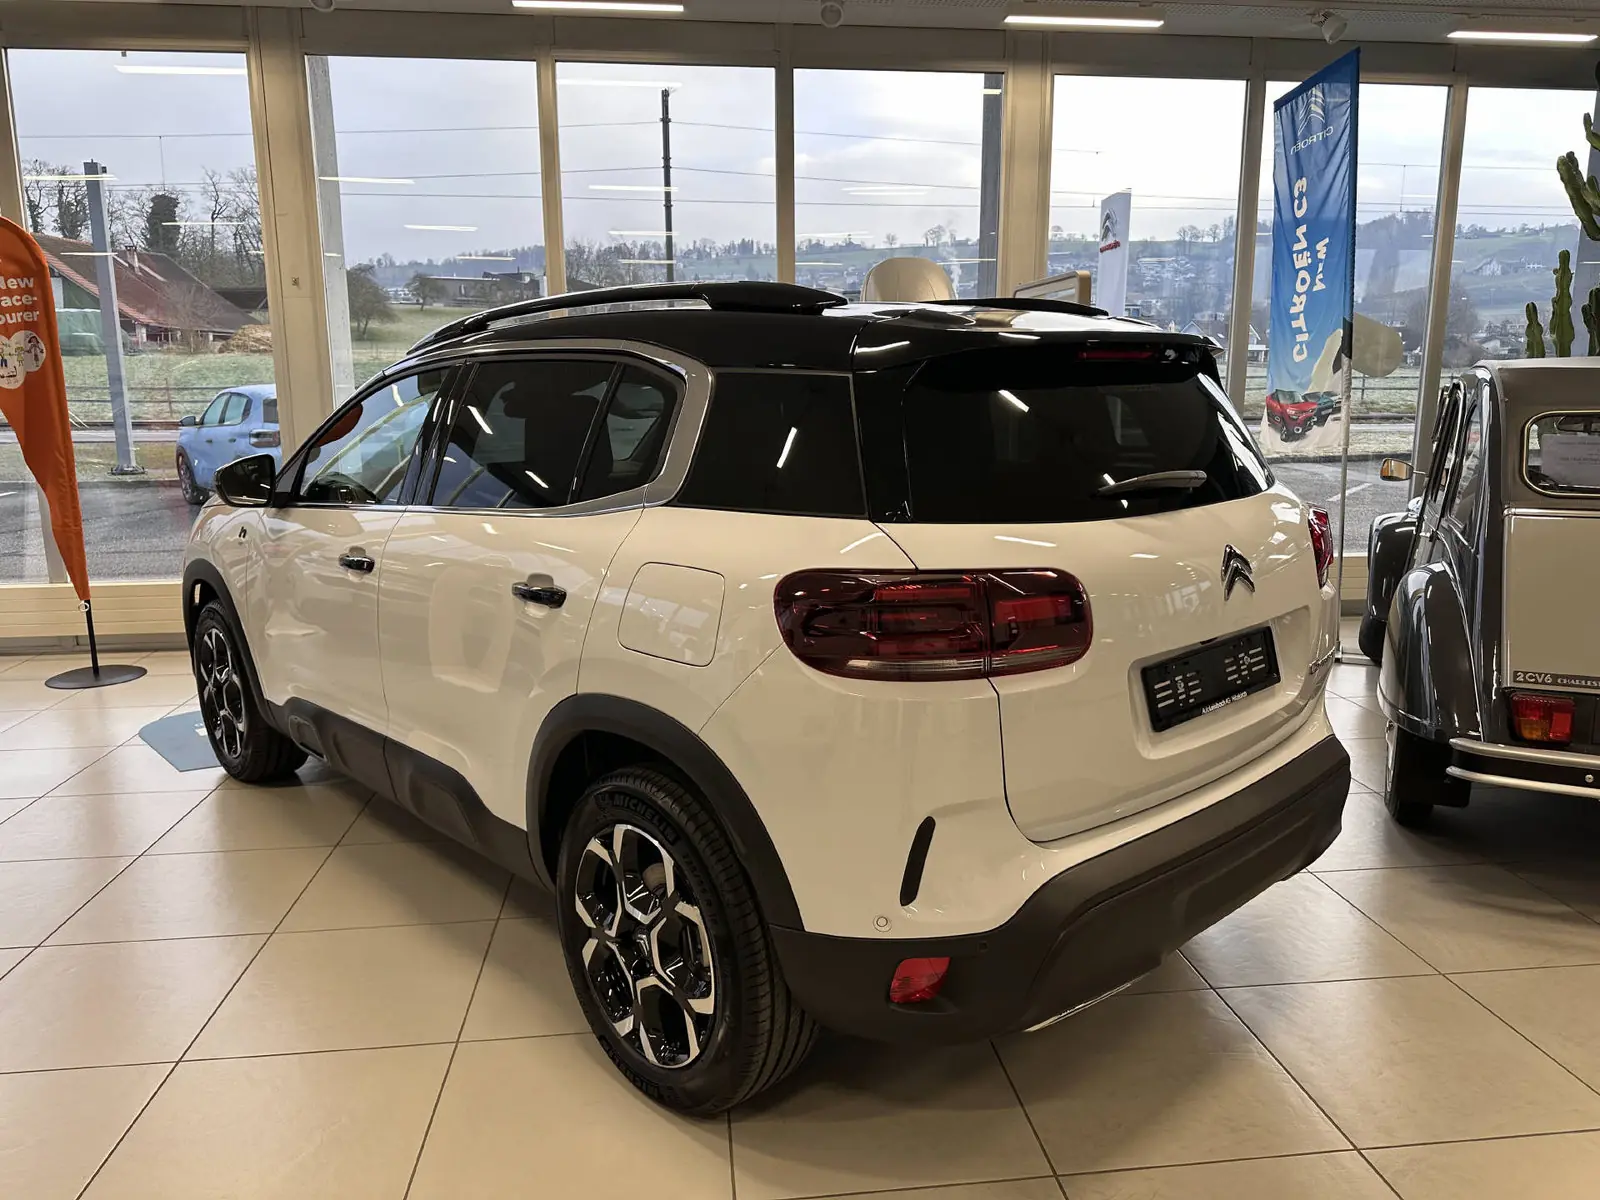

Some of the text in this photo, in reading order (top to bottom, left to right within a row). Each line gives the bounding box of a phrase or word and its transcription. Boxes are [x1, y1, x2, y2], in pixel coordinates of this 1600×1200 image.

[0, 294, 38, 307] ace-
[0, 311, 40, 324] ourer
[1516, 672, 1600, 687] 2CV6 CHARLES
[613, 793, 678, 844] MICHELIN
